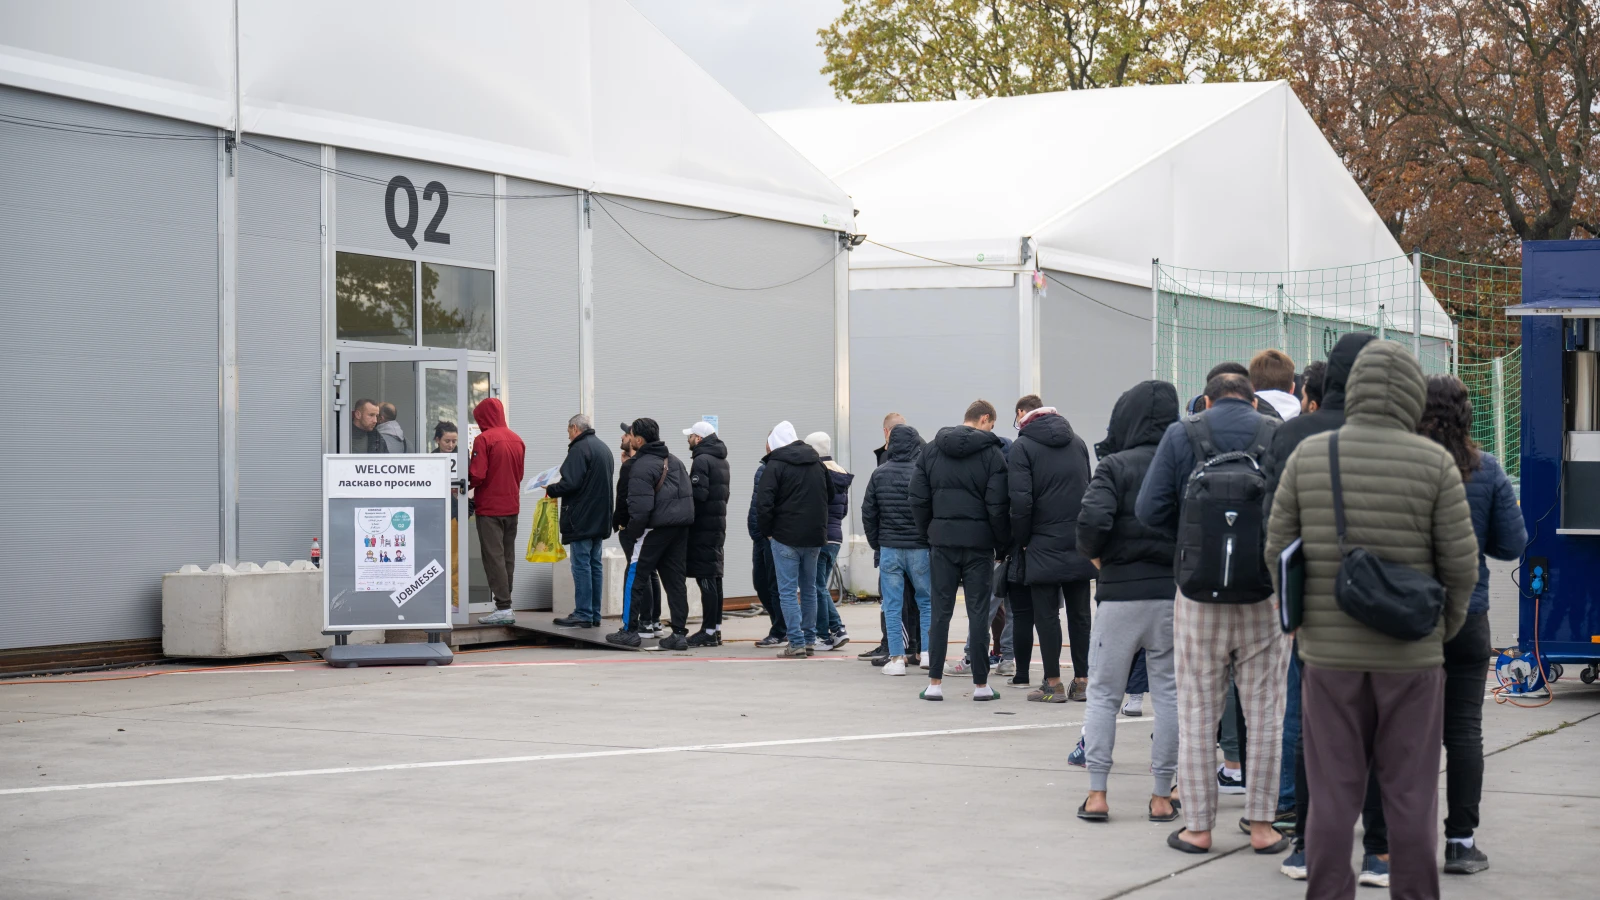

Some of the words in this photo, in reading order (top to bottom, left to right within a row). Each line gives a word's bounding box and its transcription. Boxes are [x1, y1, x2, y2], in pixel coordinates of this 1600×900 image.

[384, 175, 451, 251] Q2
[355, 464, 415, 474] WELCOME
[384, 480, 431, 489] просимо
[395, 565, 439, 604] JOBMESSE
